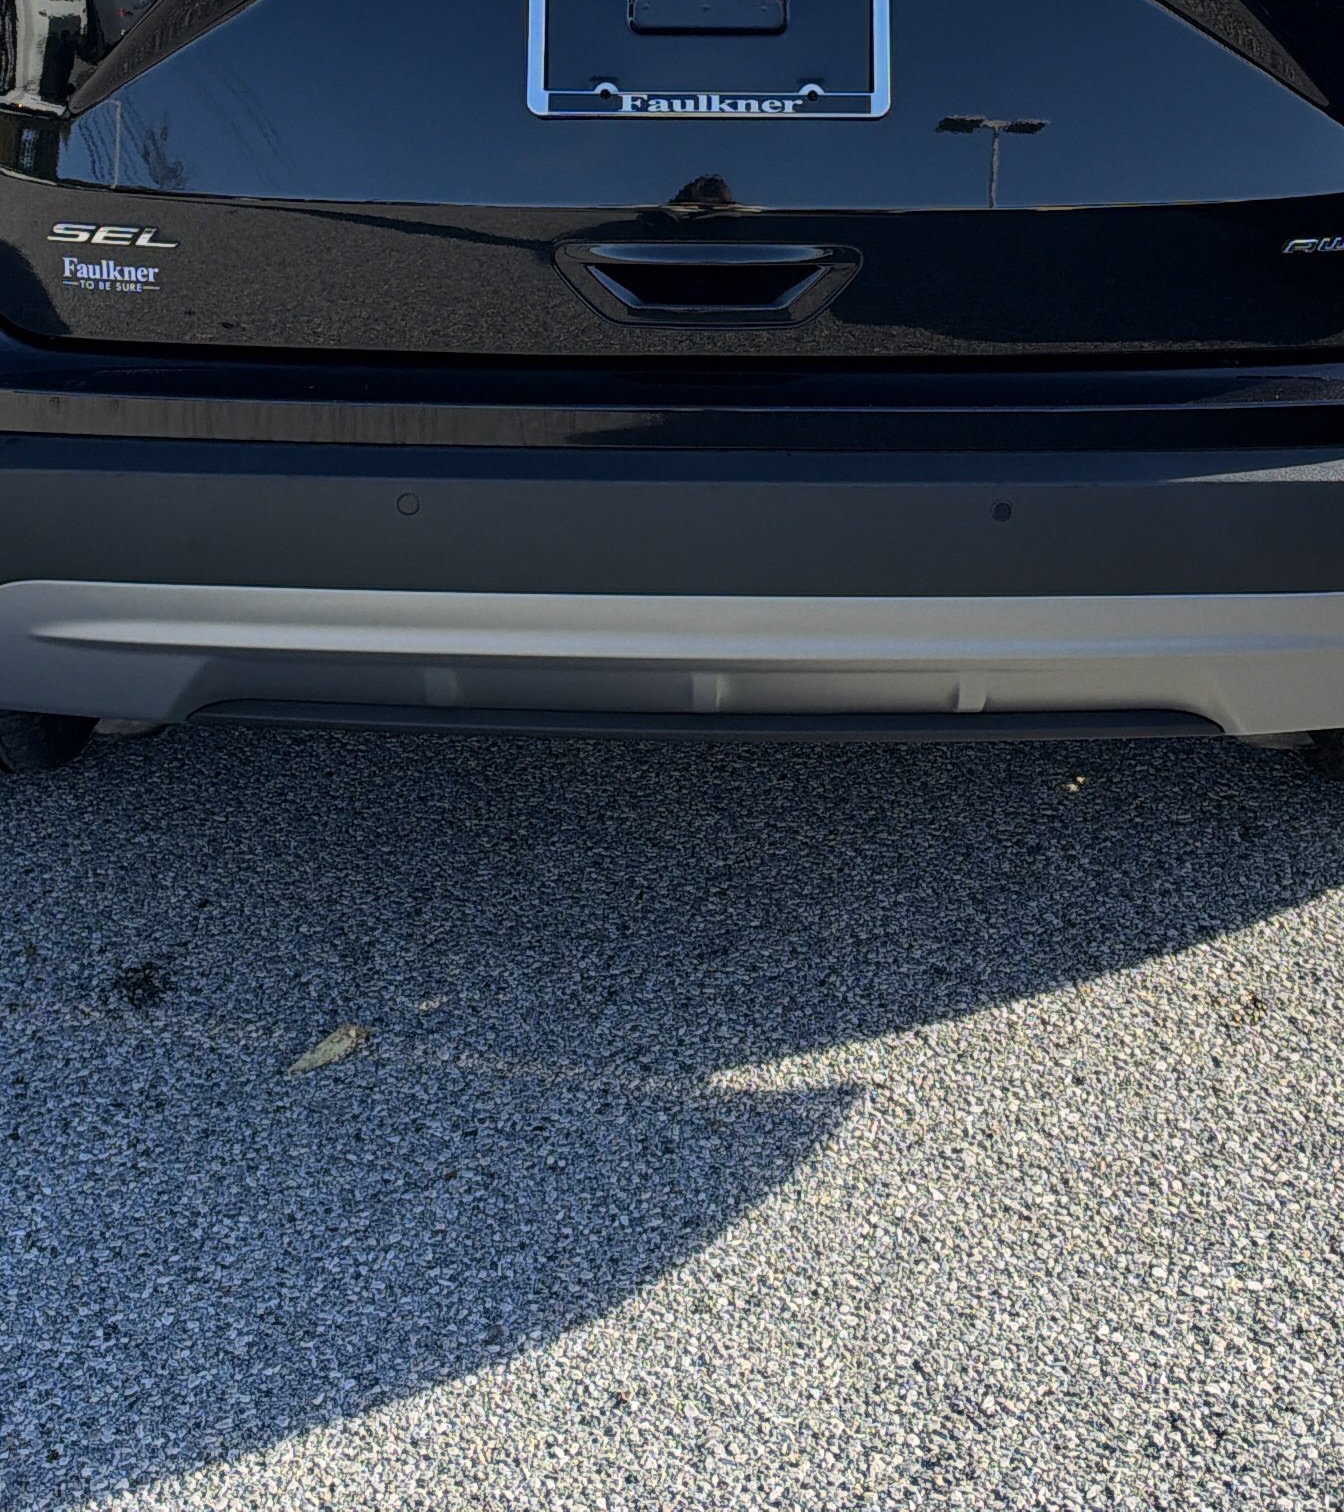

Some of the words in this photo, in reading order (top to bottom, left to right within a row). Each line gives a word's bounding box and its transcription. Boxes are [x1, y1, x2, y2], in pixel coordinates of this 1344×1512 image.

[619, 94, 803, 114] Faulkner
[47, 222, 179, 248] SEL
[62, 256, 160, 282] Faulkner
[79, 279, 95, 290] TO
[98, 281, 112, 291] BE
[115, 282, 143, 293] SURE
